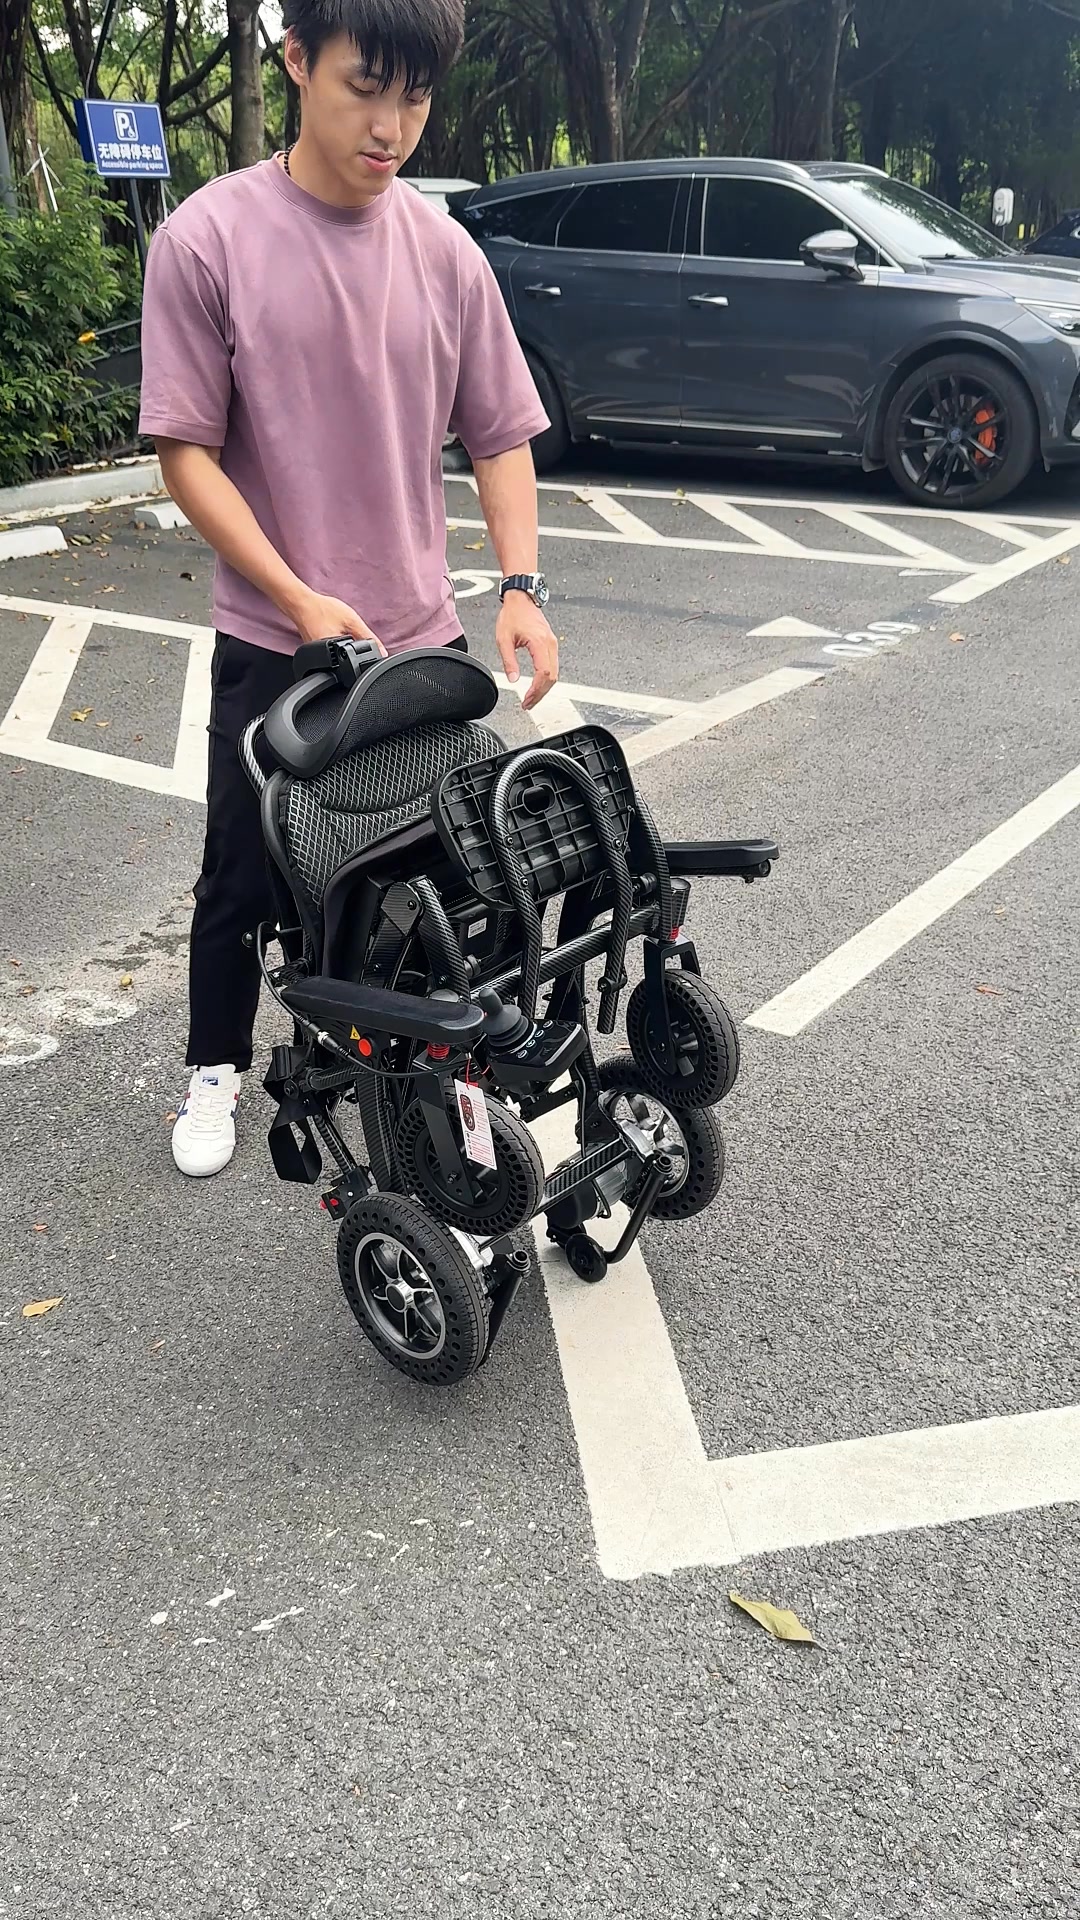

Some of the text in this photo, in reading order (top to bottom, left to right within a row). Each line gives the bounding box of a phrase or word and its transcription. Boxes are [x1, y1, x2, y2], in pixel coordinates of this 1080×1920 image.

[116, 112, 129, 137] P
[98, 143, 163, 160] 无障碍停车位
[102, 160, 164, 171] Accessible parking space
[822, 621, 920, 657] 039
